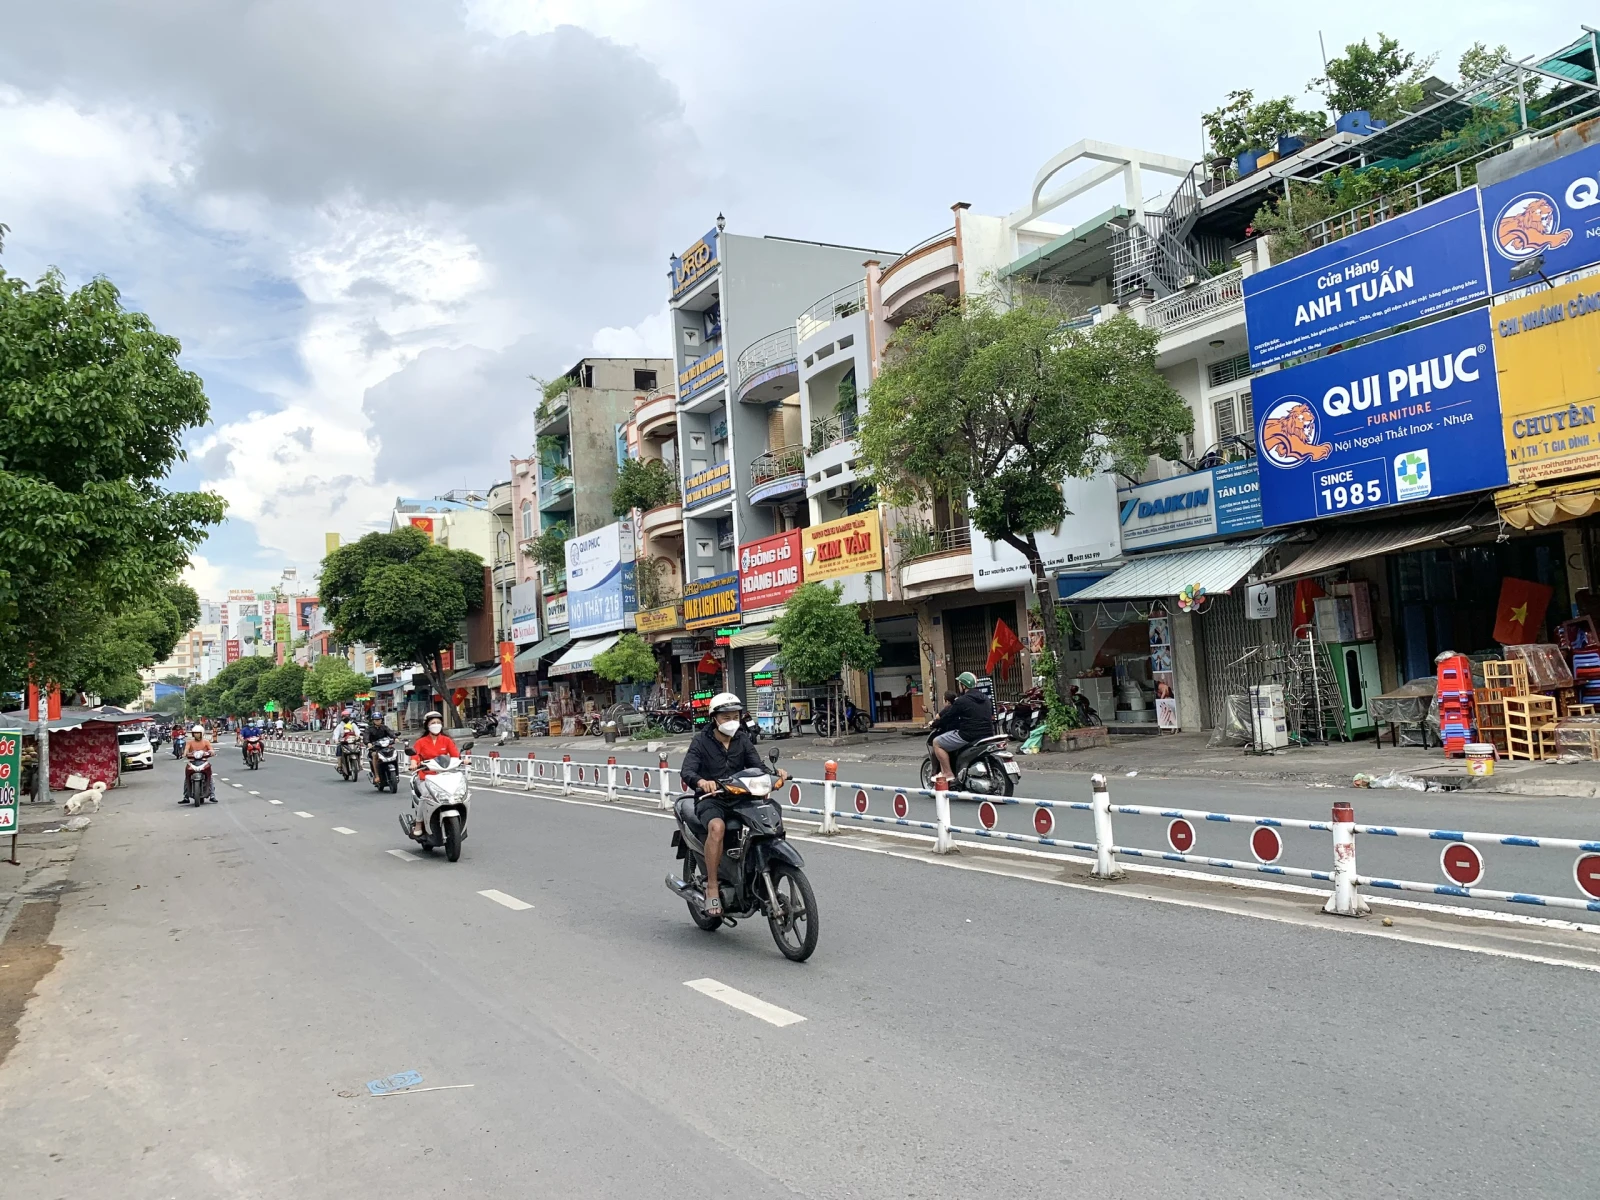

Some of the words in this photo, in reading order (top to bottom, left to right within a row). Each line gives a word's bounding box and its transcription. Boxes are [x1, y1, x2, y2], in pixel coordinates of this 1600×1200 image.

[1317, 269, 1342, 290] Cửa
[1344, 258, 1379, 278] Hàng
[1295, 291, 1342, 327] ANH
[1345, 266, 1414, 307] TUẤN
[1498, 316, 1519, 338] CHI
[1521, 304, 1564, 332] NHÁNH
[1322, 374, 1382, 417] QUI
[1388, 346, 1480, 403] PHUC
[1367, 401, 1432, 427] FURNITURE
[1512, 403, 1596, 439] CHUYÊN
[1334, 439, 1351, 452] Nội
[1354, 433, 1383, 449] Ngoại
[1385, 425, 1408, 440] Thất
[1409, 422, 1434, 435] Inox
[1443, 413, 1474, 428] Nhựa
[1552, 439, 1566, 452] GIA
[1568, 434, 1589, 449] ĐÌNH
[1217, 486, 1237, 499] TÂN
[1320, 470, 1354, 486] SINCE
[1138, 488, 1209, 519] DAIKIN
[1321, 479, 1382, 510] 1985
[580, 541, 588, 553] QUI
[751, 545, 776, 568] ĐỒNG
[776, 537, 791, 560] HỒ
[817, 539, 842, 562] KIM
[843, 530, 871, 555] VÂN
[742, 570, 773, 594] HOÀNG
[772, 566, 798, 588] LONG
[571, 600, 584, 622] NỘI
[584, 594, 603, 617] THẤT
[605, 594, 619, 613] 215
[624, 595, 636, 603] 215
[699, 589, 736, 618] LIGHTINGS
[571, 662, 582, 670] KIM
